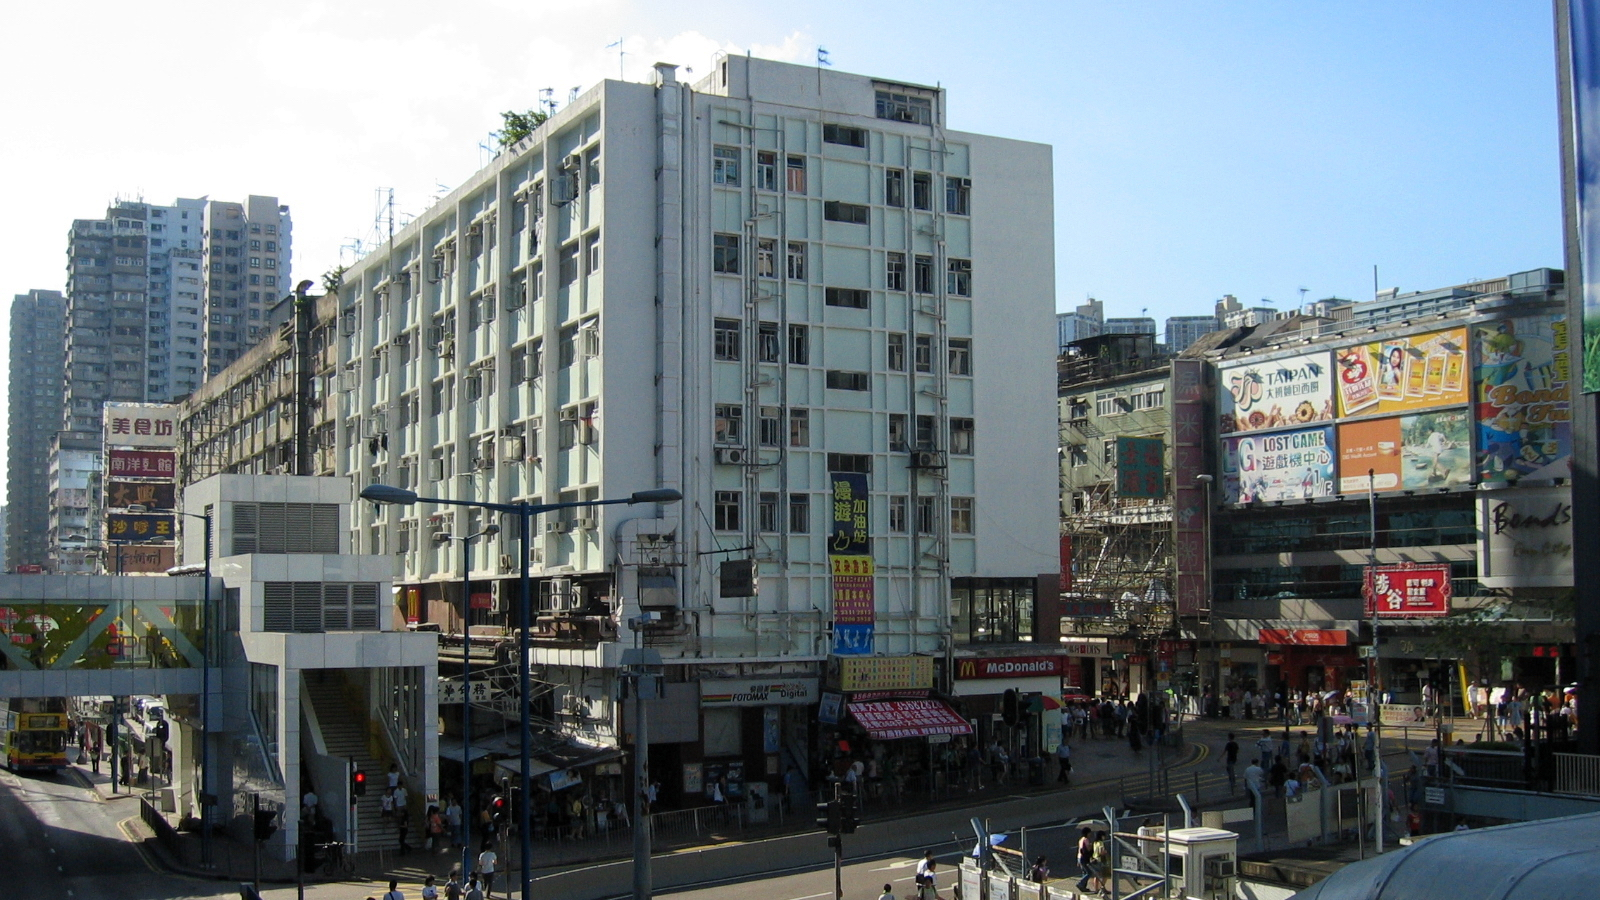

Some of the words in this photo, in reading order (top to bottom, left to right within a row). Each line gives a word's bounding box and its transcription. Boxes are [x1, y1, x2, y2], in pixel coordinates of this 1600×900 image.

[1266, 366, 1319, 386] TAIPAN
[112, 418, 173, 436] 美食坊
[1263, 436, 1290, 453] LOST
[1262, 449, 1330, 471] 遊戲機中心
[853, 499, 867, 543] 加油站
[986, 659, 1054, 674] McDonald's
[732, 692, 769, 702] FOTOMAX
[780, 688, 808, 699] Digital
